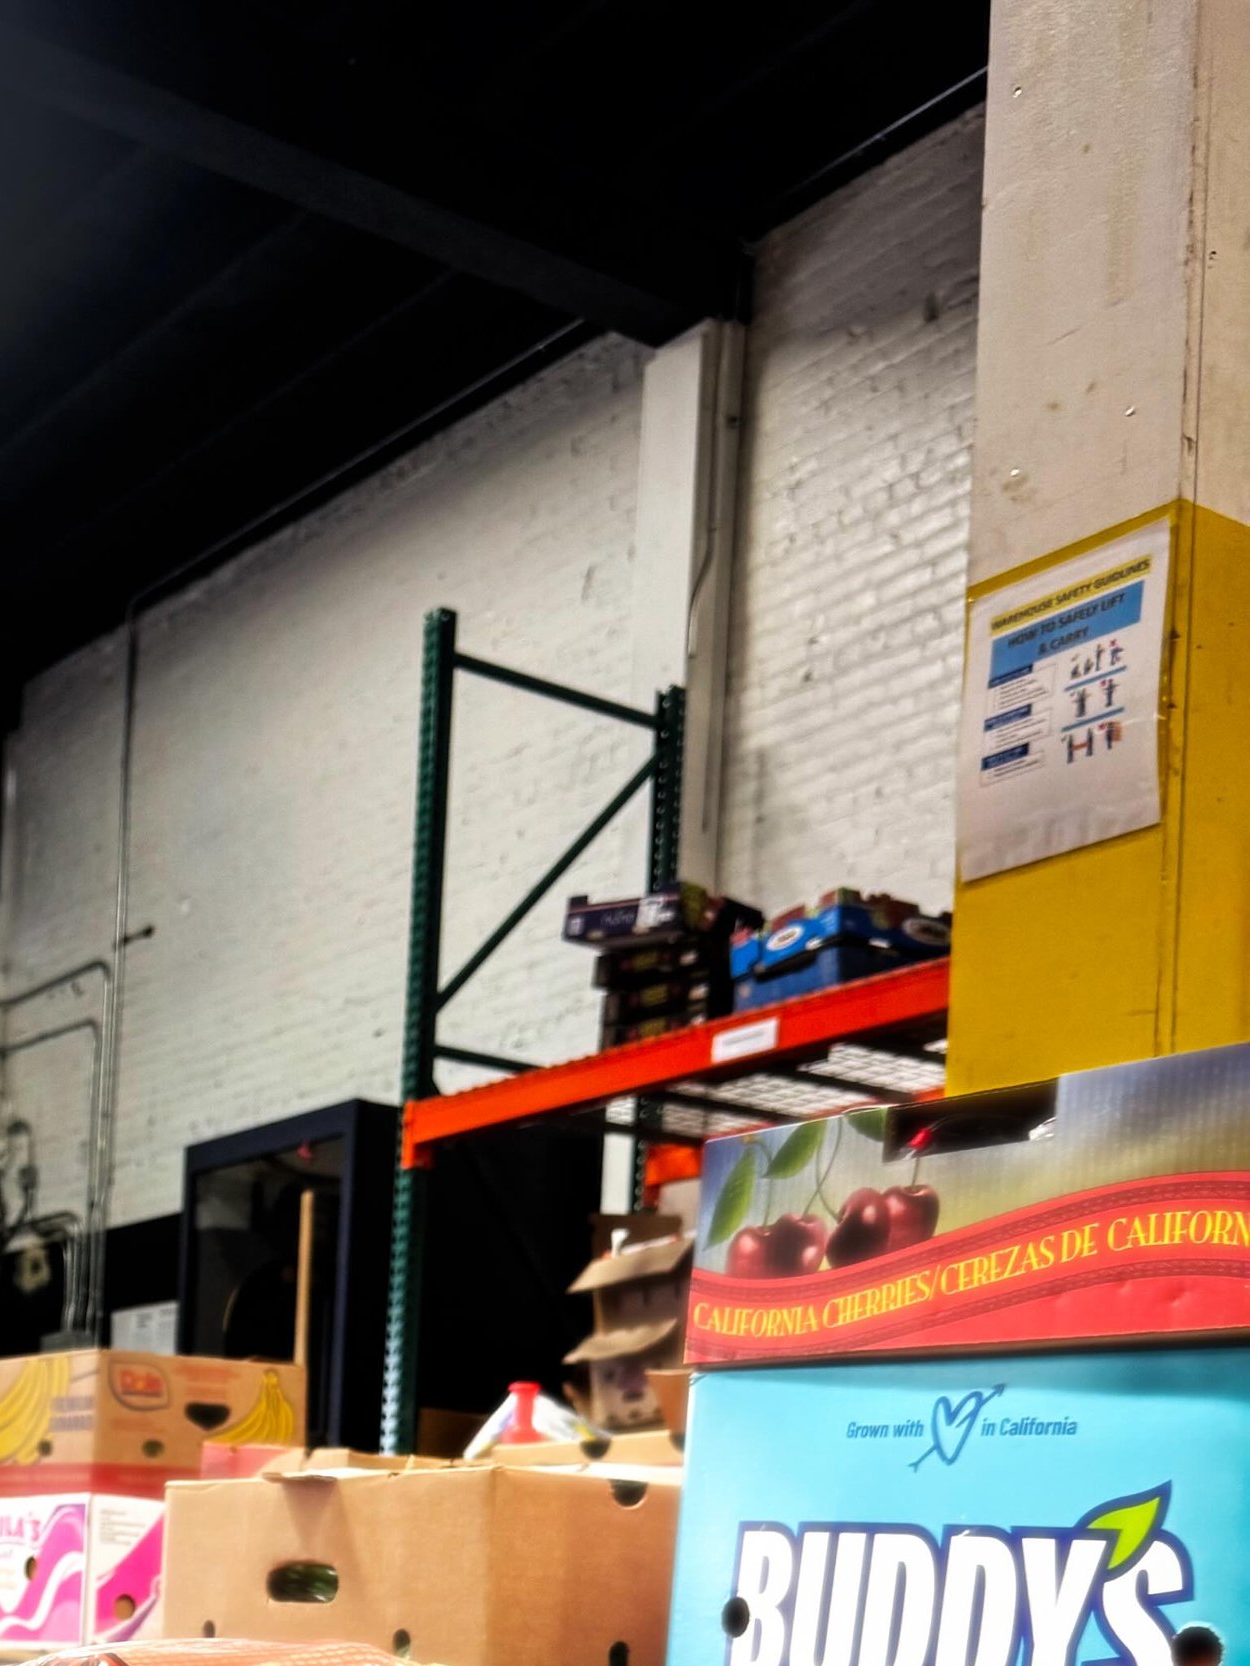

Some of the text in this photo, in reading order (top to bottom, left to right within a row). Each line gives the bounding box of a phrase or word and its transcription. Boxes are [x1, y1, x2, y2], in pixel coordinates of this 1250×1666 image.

[992, 599, 1053, 630] WAREHOUSE
[1056, 583, 1092, 604] SAFETY
[1008, 592, 1125, 647] HOW TO SAFELY LIFT
[1050, 626, 1089, 650] CARRY
[693, 1302, 819, 1338] CALIFORNIA
[1061, 1222, 1100, 1263] DE
[846, 1416, 1078, 1439] Grown with in California
